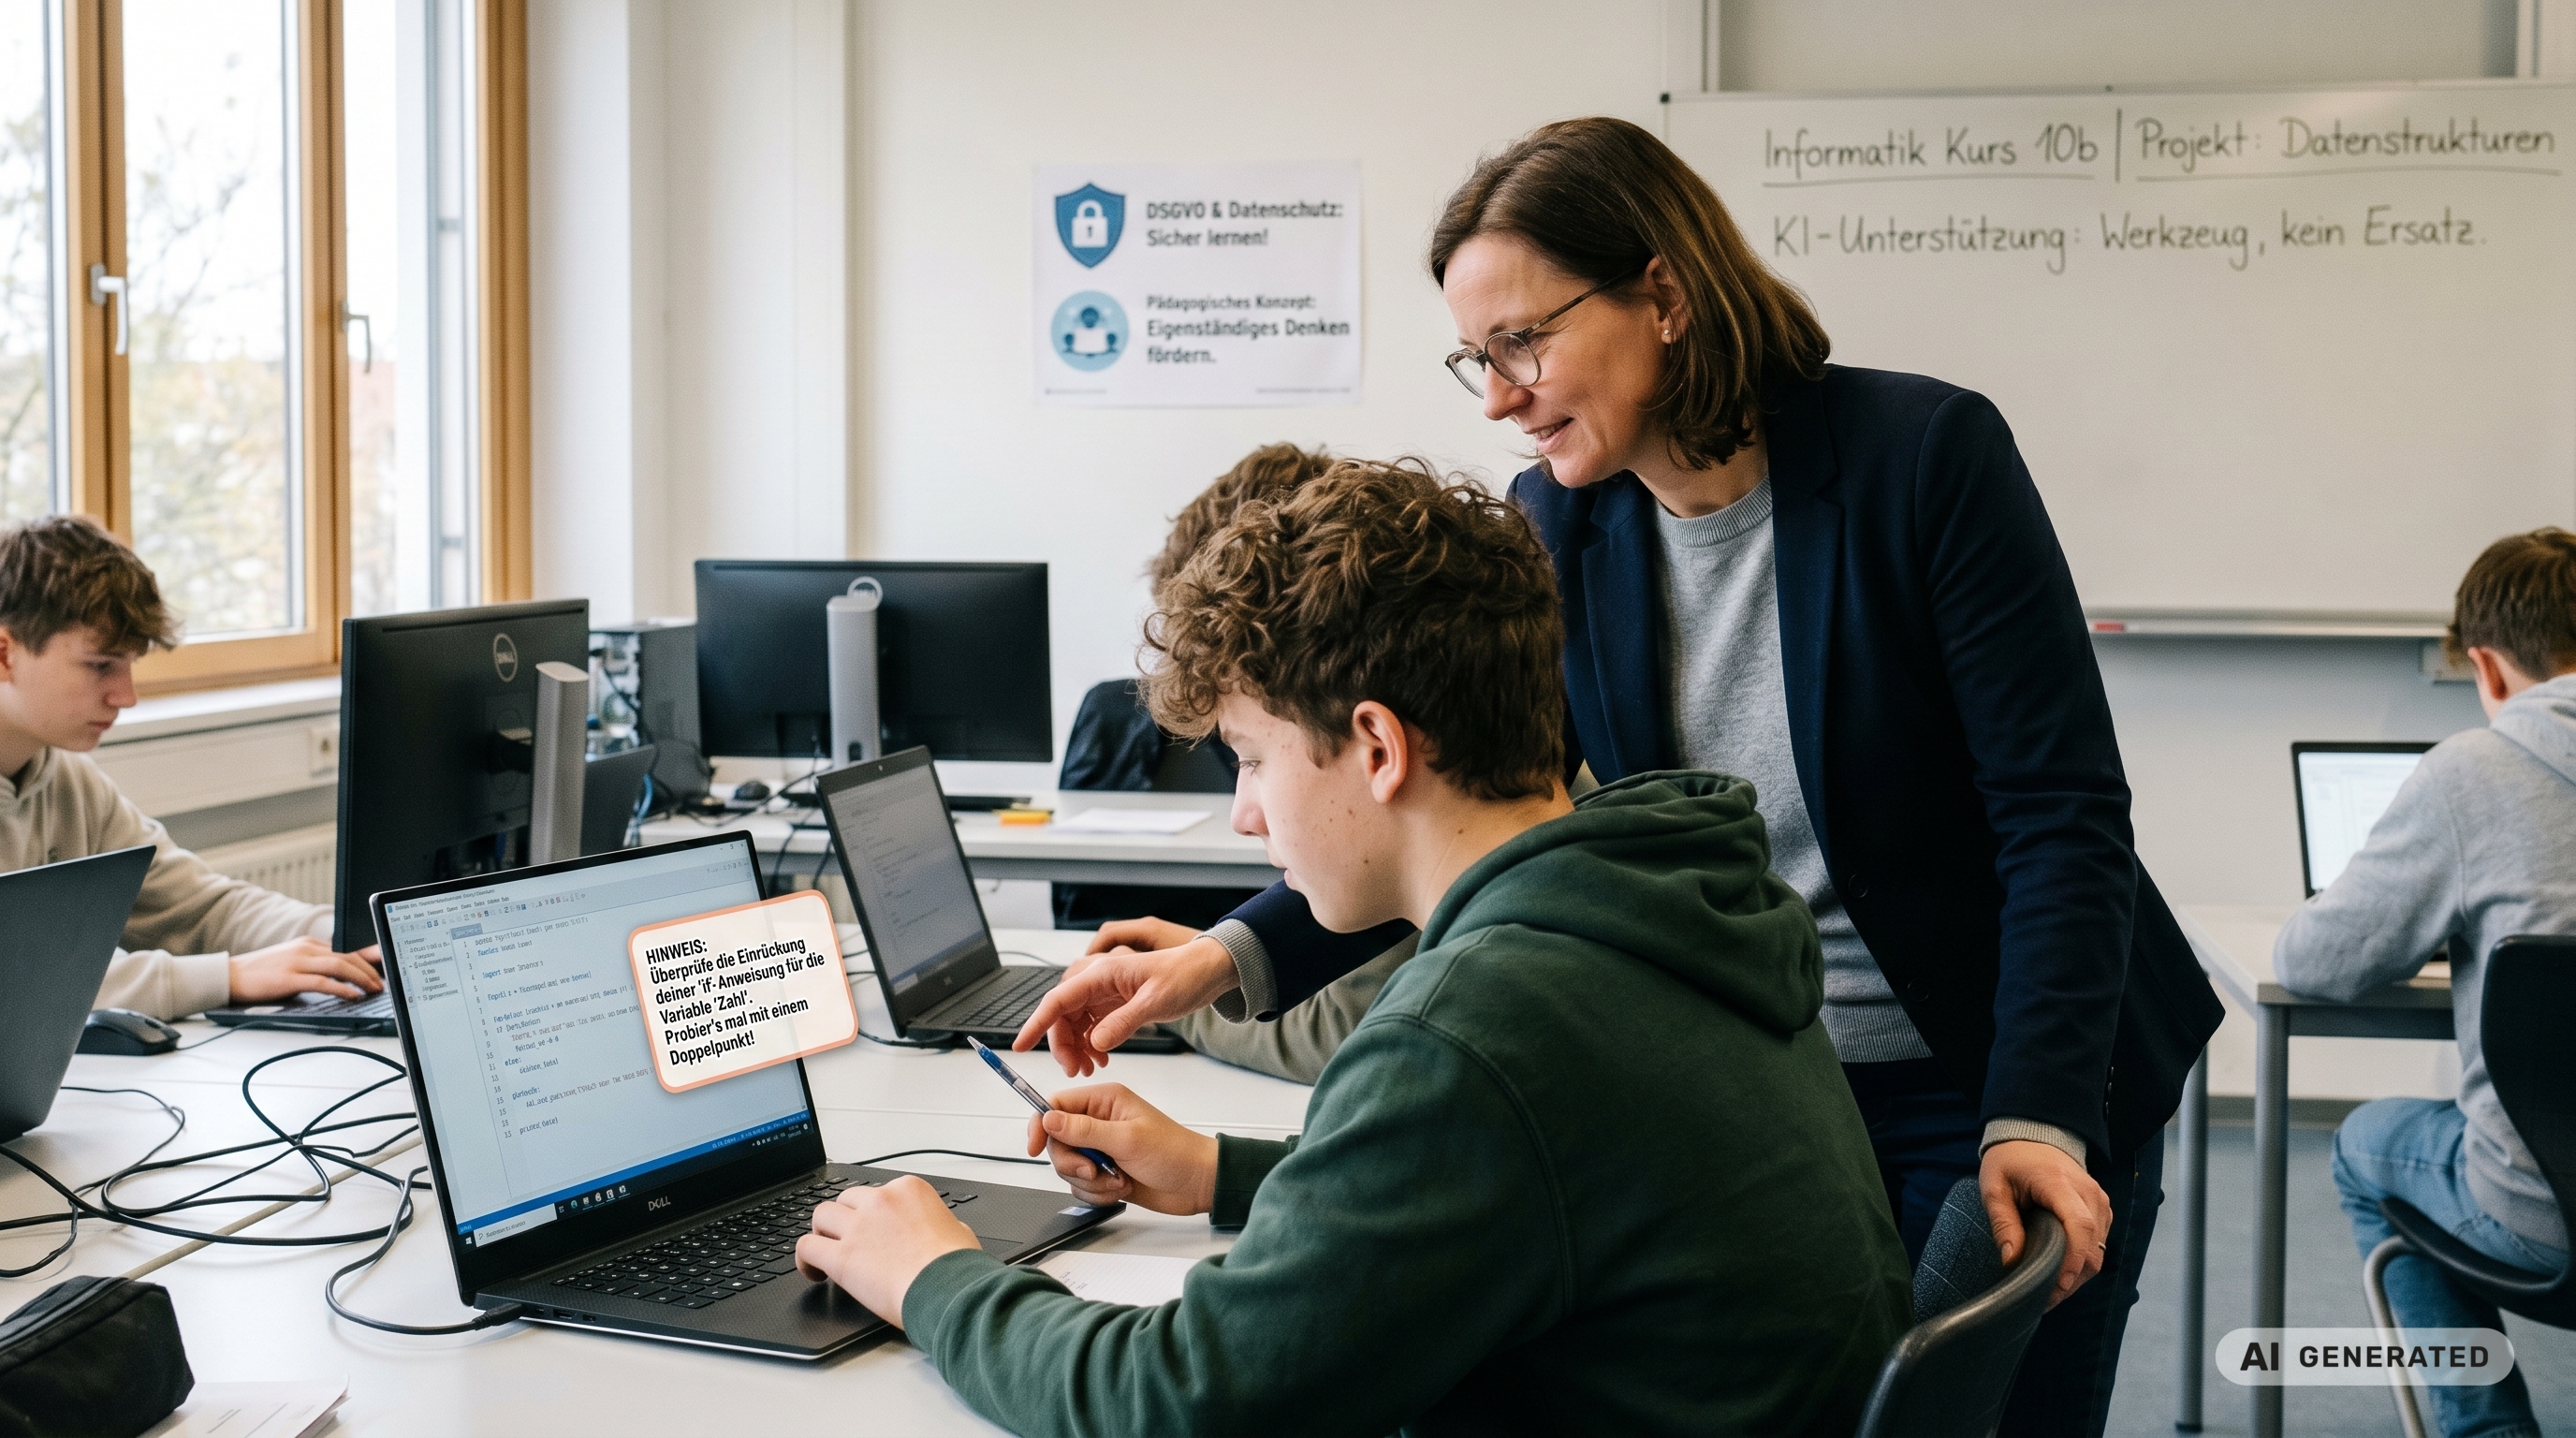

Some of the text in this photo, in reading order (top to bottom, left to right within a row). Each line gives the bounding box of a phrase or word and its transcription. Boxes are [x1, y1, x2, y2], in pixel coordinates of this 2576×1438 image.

[1764, 127, 1927, 180] Informatik
[1945, 126, 2017, 166] Kurs
[2035, 122, 2100, 164] 10b
[2134, 115, 2262, 174] Projekt:
[2278, 114, 2555, 159] Datenstrukturen
[1147, 199, 1344, 220] DSGVO & Datenschutz:
[1147, 227, 1269, 247] Sicher lernen!
[1774, 204, 2488, 275] KI-Unterstützung: Werkzeug, kein Ersatz.
[1147, 295, 1316, 313] Pädagogisches Konzept:
[1147, 318, 1350, 341] Eigenständiges Denken
[1147, 345, 1217, 364] fördern.
[645, 939, 708, 965] HINWEIS:
[650, 938, 806, 985] Überprüfe die Einrückung
[655, 986, 696, 1005] deiner
[786, 957, 804, 974] für
[806, 951, 826, 968] die
[659, 1000, 712, 1025] Variable
[665, 1018, 724, 1046] Probier's
[724, 1010, 748, 1031] mal
[748, 1005, 770, 1024] mit
[771, 998, 810, 1019] einem
[669, 1030, 755, 1065] Doppelpunkt!
